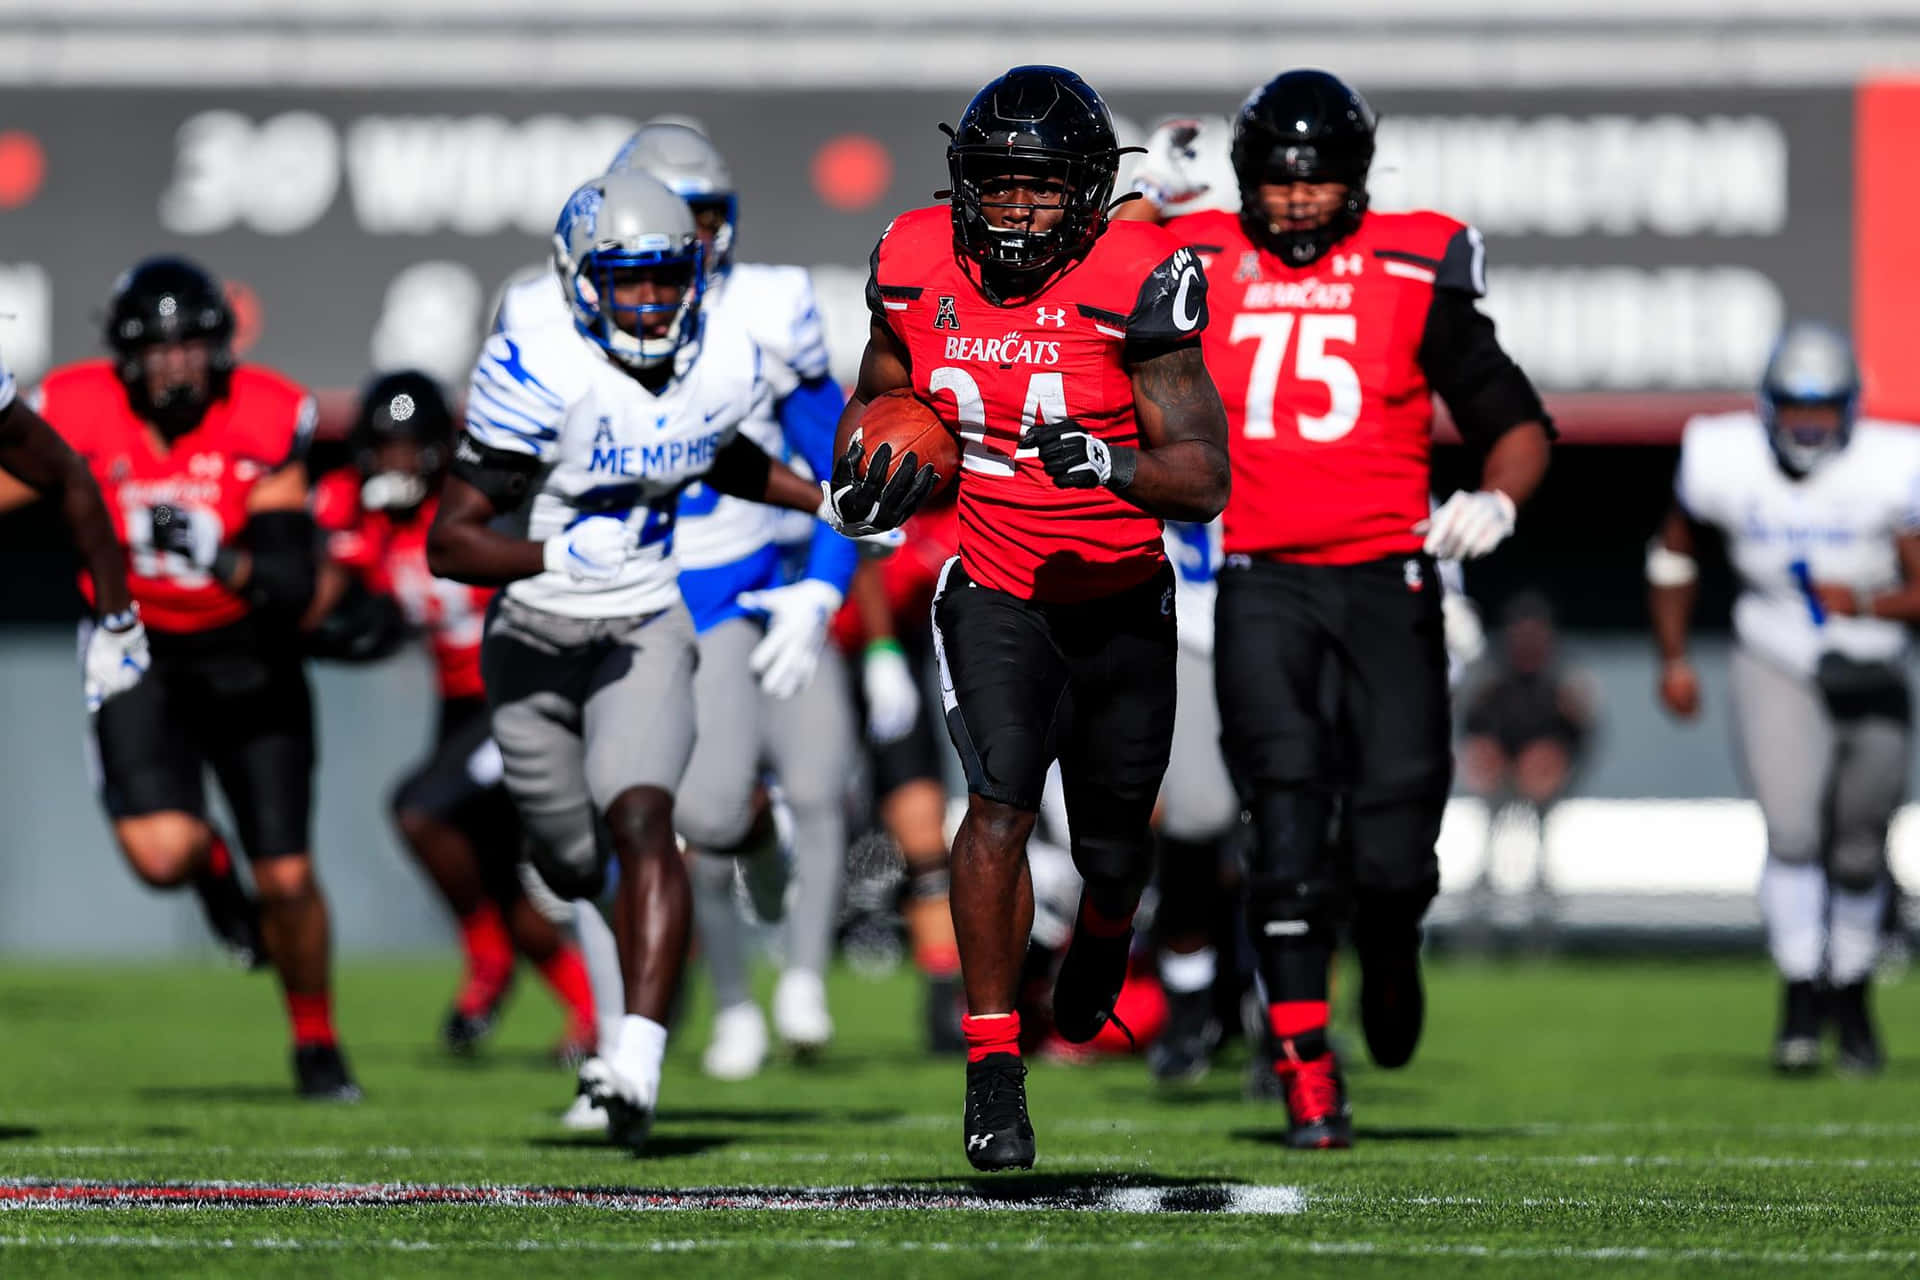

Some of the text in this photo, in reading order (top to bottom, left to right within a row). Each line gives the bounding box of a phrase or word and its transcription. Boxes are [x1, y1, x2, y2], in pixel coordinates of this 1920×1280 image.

[944, 332, 1061, 365] BEARCATS
[1229, 312, 1363, 443] 75
[587, 432, 722, 477] MEMPHIS
[929, 366, 1070, 477] 24
